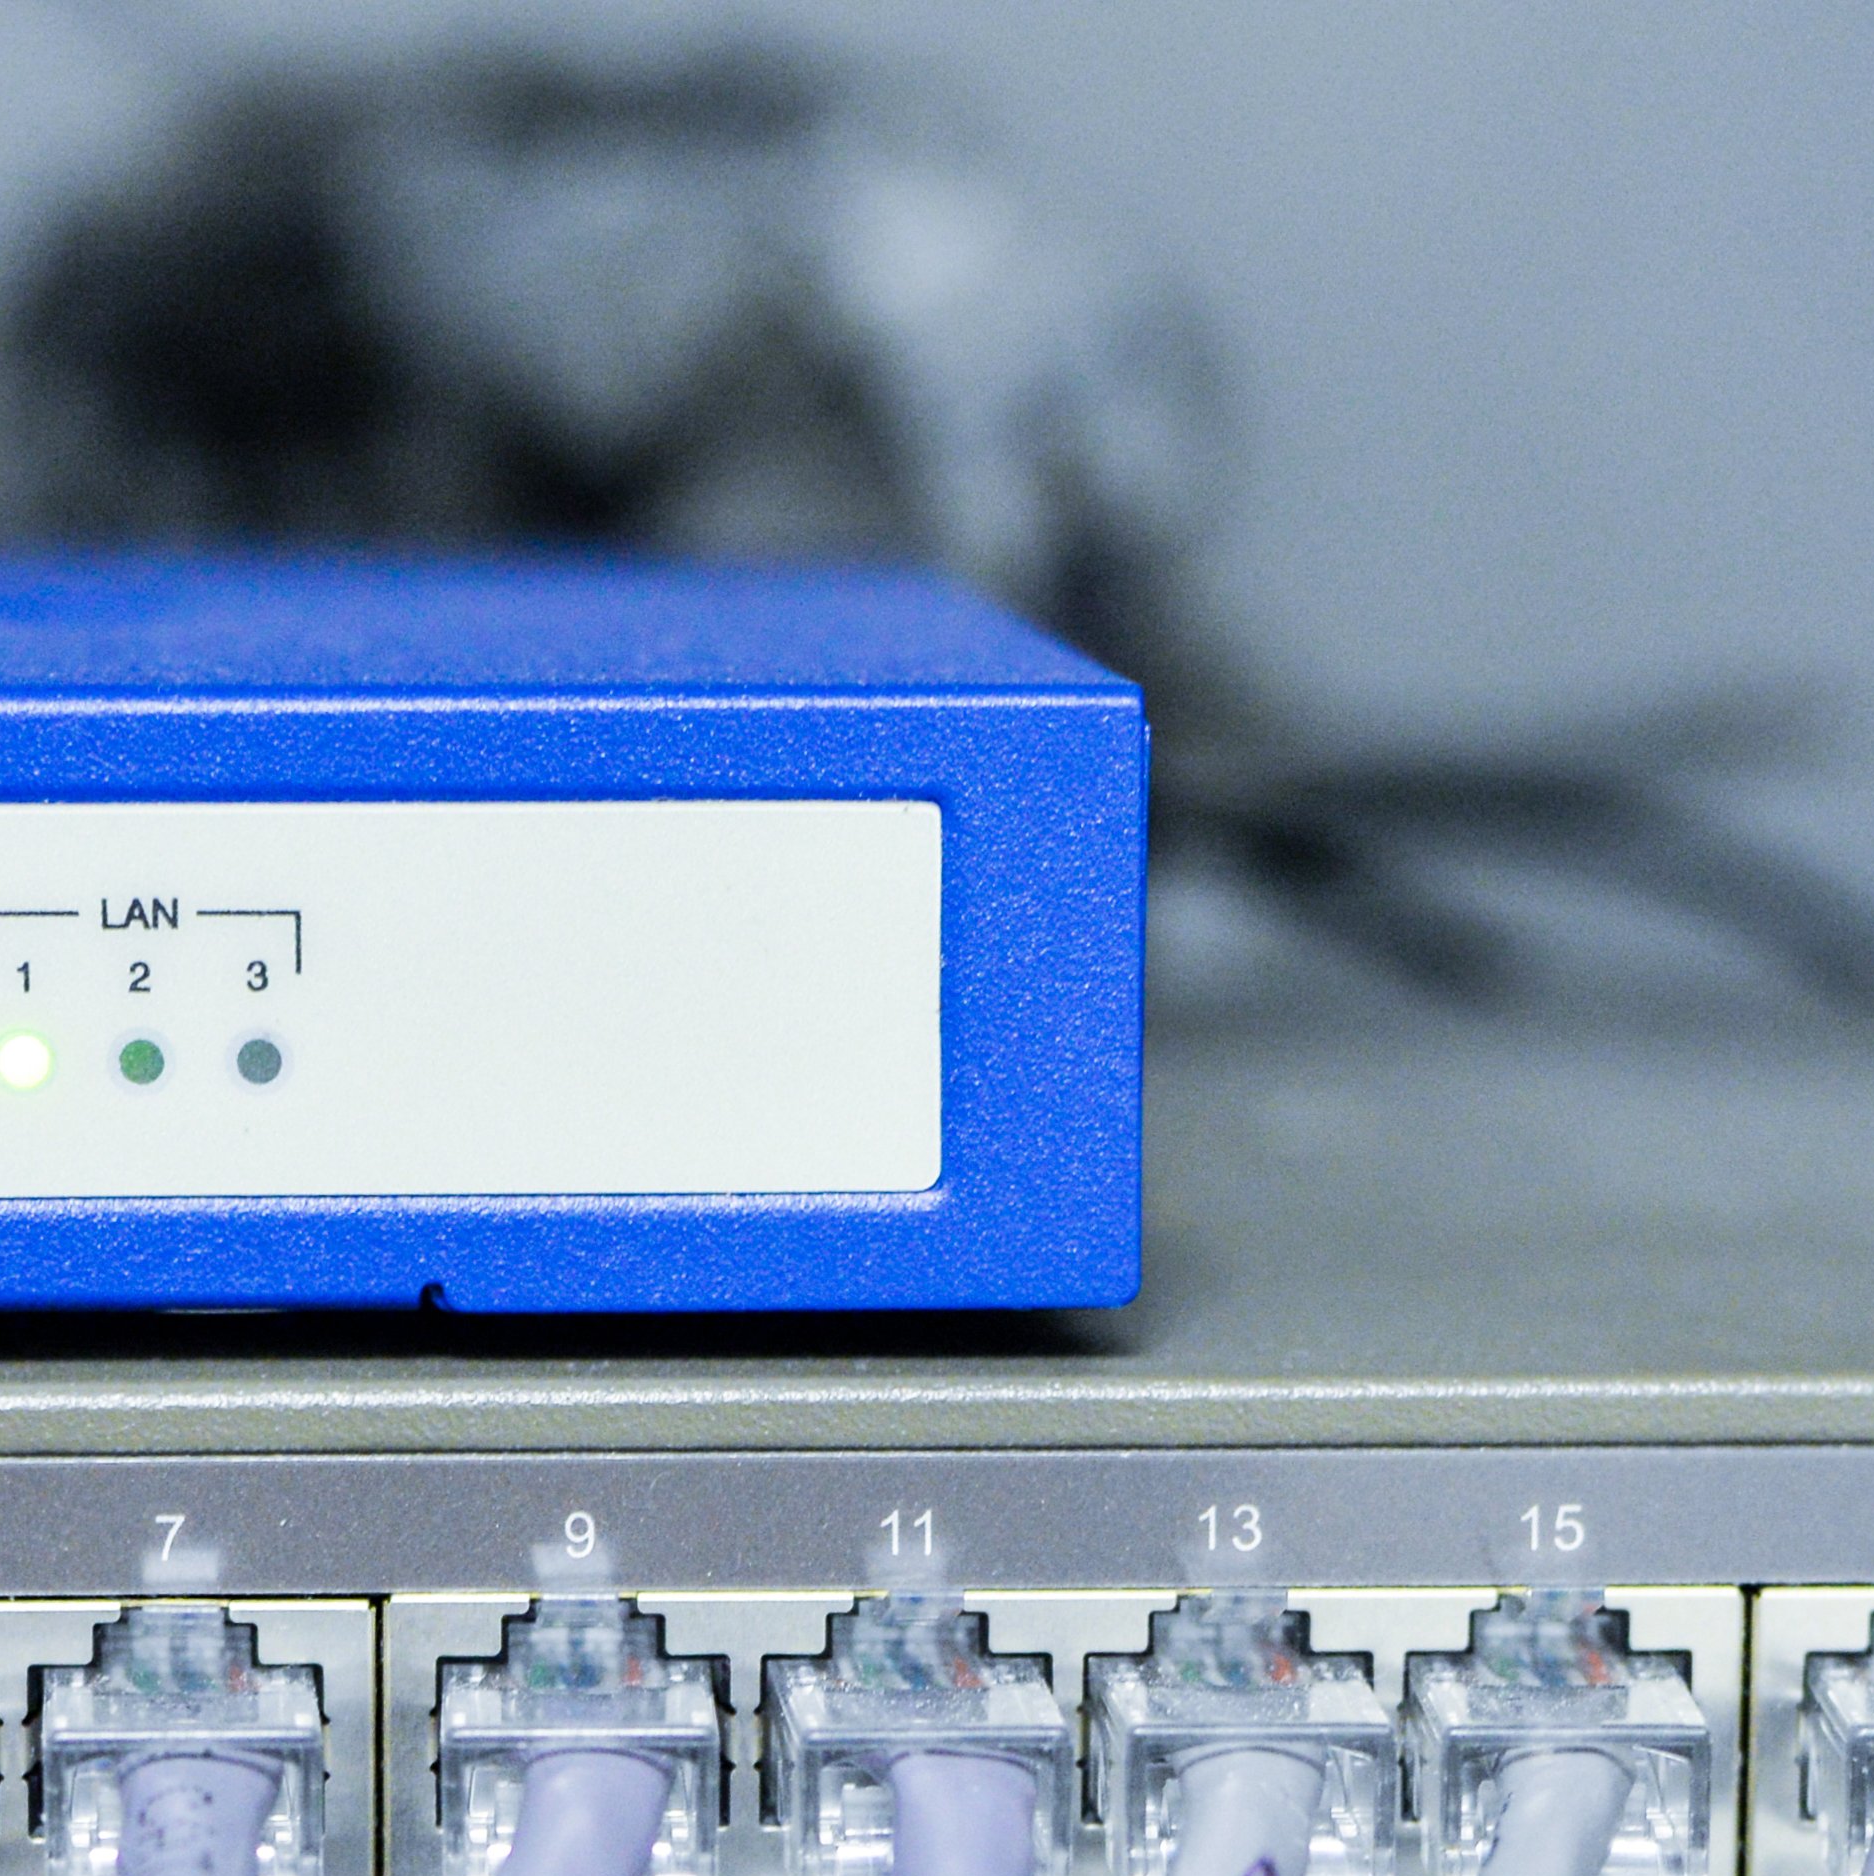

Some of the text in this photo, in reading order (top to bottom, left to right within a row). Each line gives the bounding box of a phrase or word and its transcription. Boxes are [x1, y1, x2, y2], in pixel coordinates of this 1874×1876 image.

[101, 897, 179, 930] LAN
[17, 961, 31, 993] 1
[128, 961, 151, 993] 2
[246, 960, 269, 992] 3
[154, 1513, 187, 1560] 7
[563, 1510, 597, 1558] 9
[880, 1508, 936, 1556] 11
[1199, 1504, 1263, 1554] 13
[1521, 1504, 1585, 1553] 15
